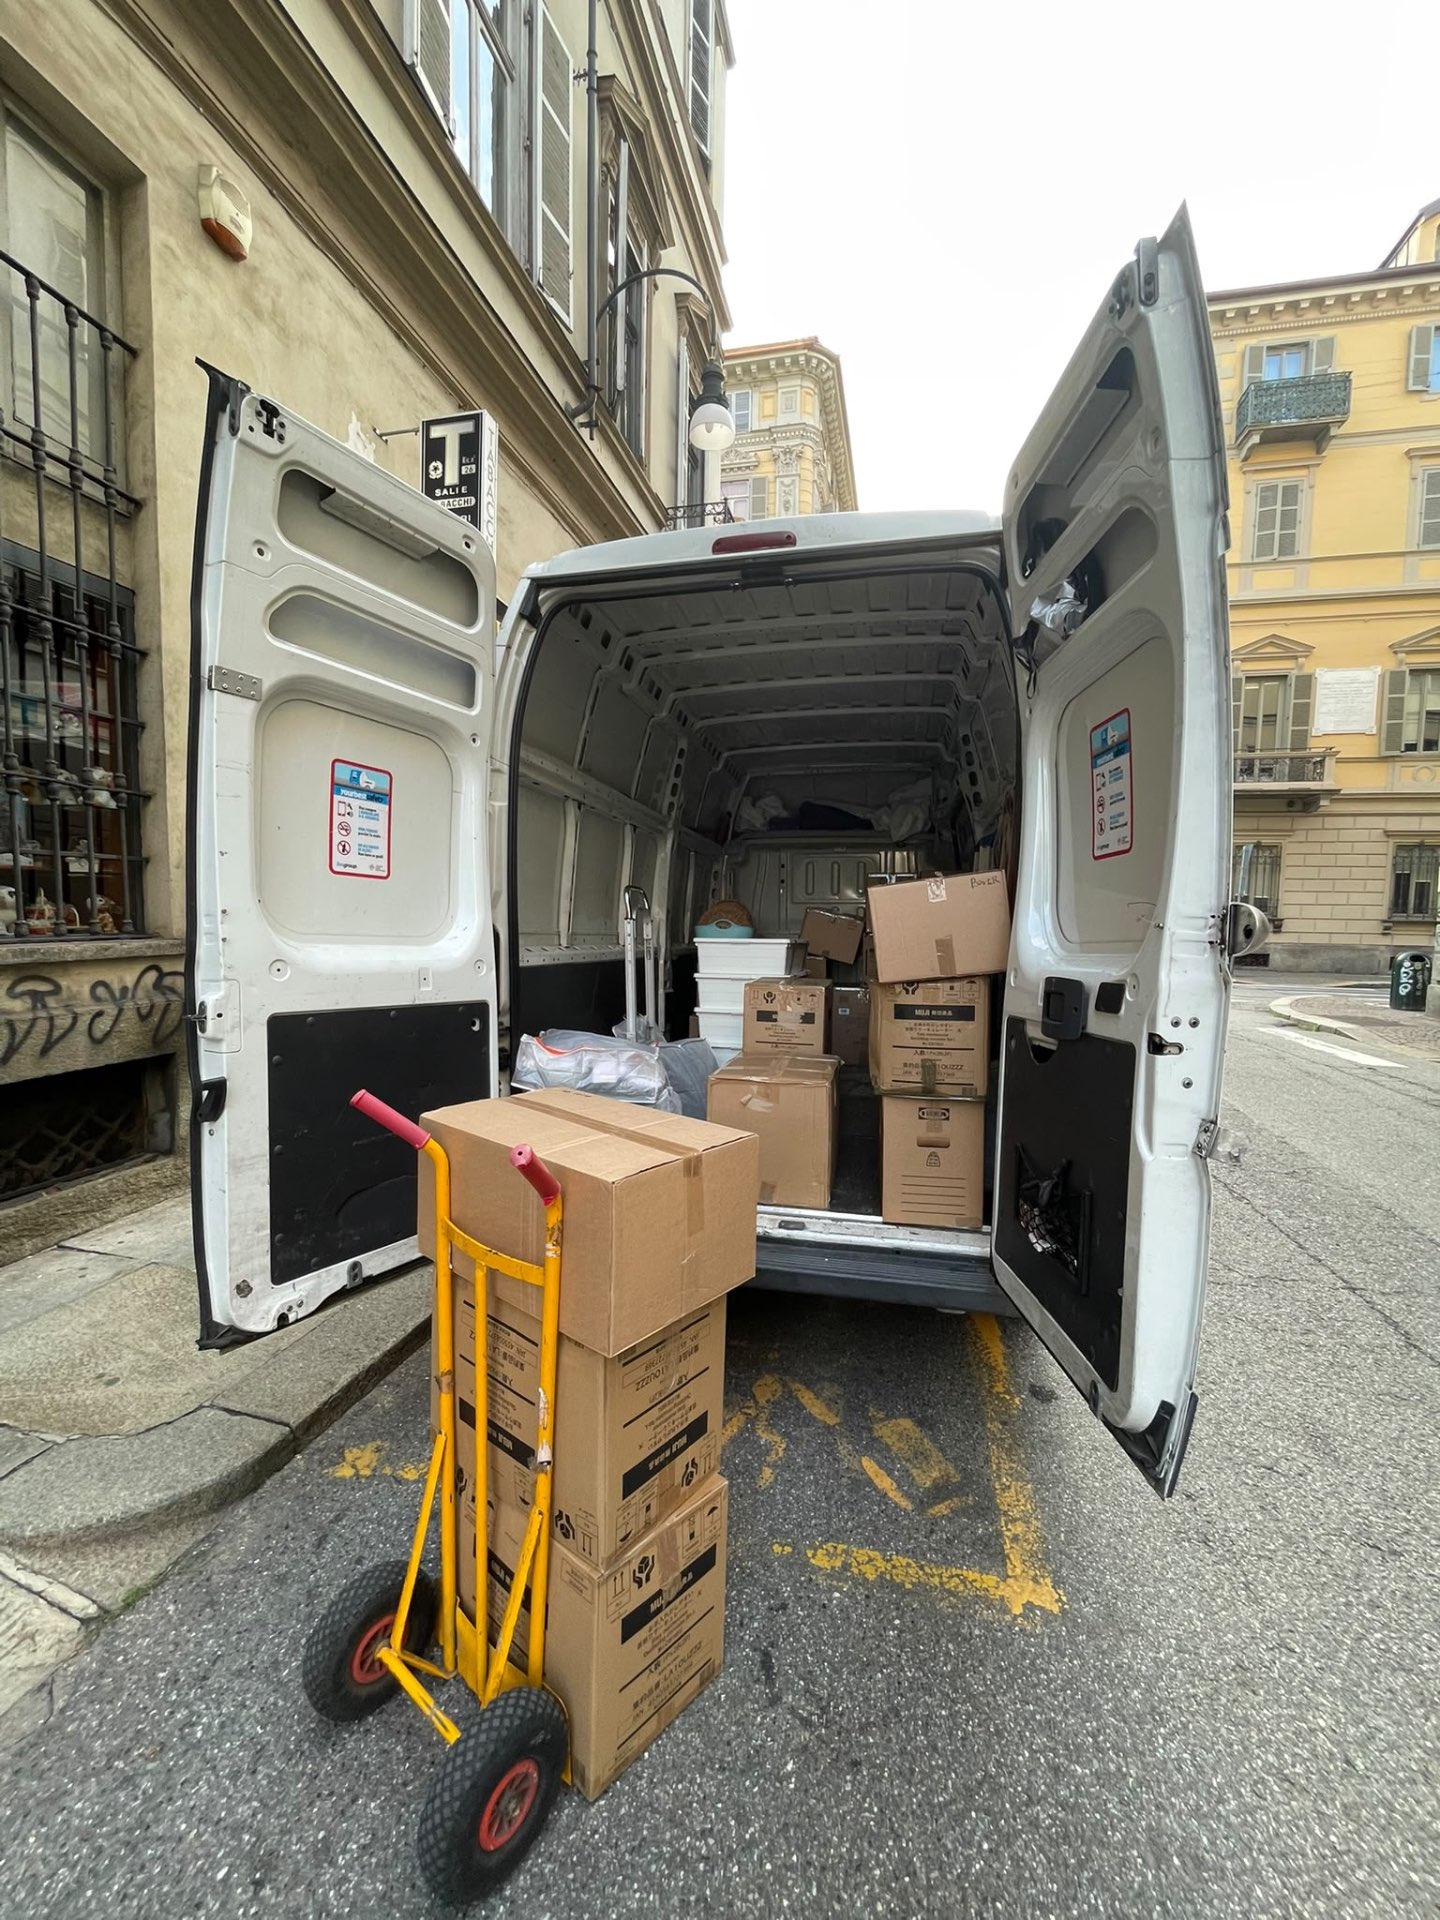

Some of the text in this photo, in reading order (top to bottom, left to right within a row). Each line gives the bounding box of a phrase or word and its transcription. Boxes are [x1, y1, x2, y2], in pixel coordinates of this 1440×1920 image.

[429, 420, 475, 486] T
[434, 485, 468, 497] SALI E
[486, 427, 495, 550] TABACCH
